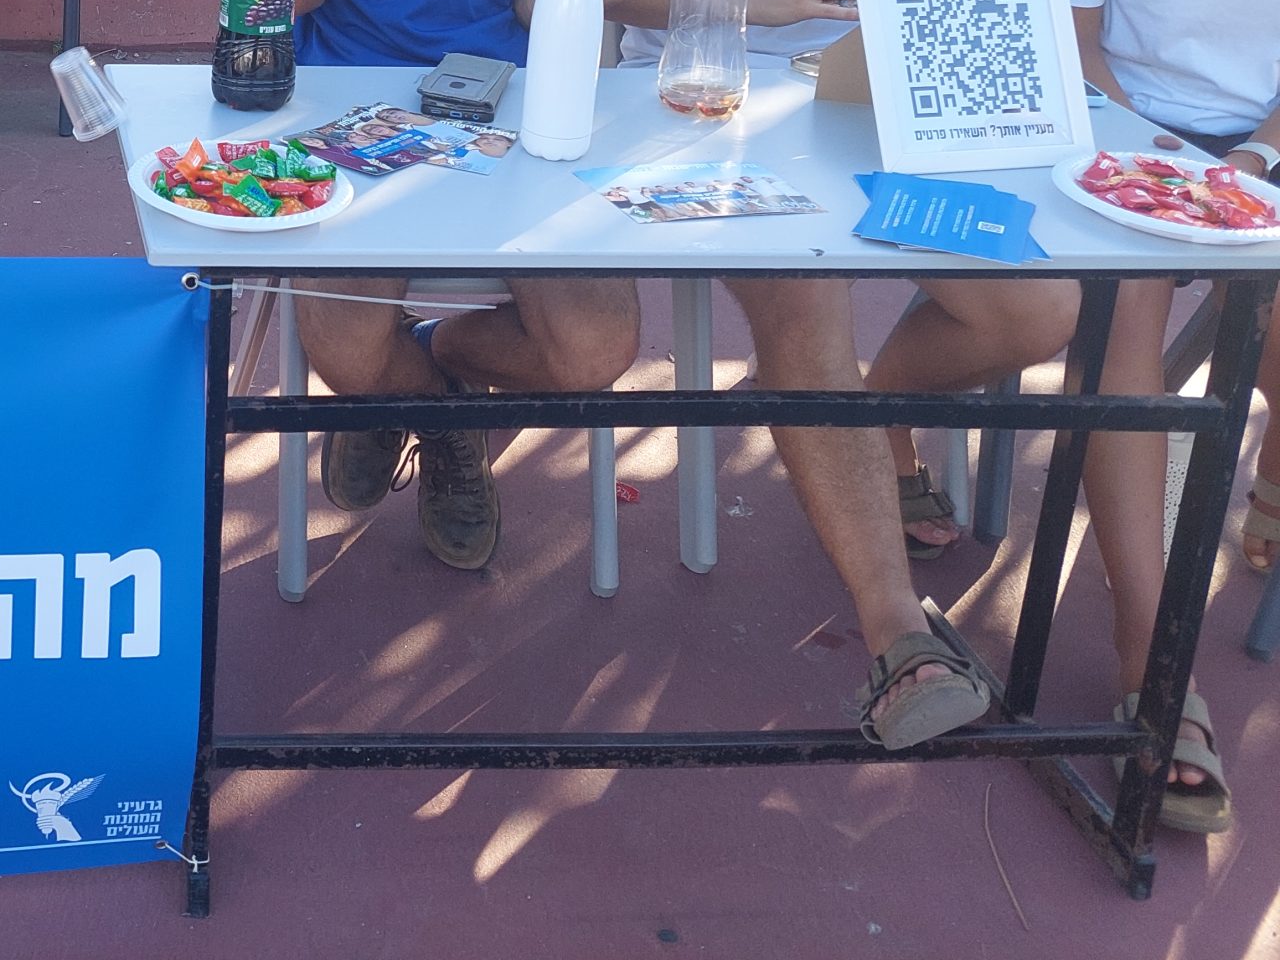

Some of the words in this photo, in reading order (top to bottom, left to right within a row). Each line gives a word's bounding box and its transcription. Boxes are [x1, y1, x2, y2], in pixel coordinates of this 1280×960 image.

[914, 129, 947, 141] פרטים
[949, 127, 987, 139] השאירו
[990, 124, 1022, 139] אותך?
[1023, 123, 1055, 138] מעניין
[117, 799, 163, 813] גרעיני
[103, 812, 162, 826] המחנות
[106, 824, 160, 837] העולים
